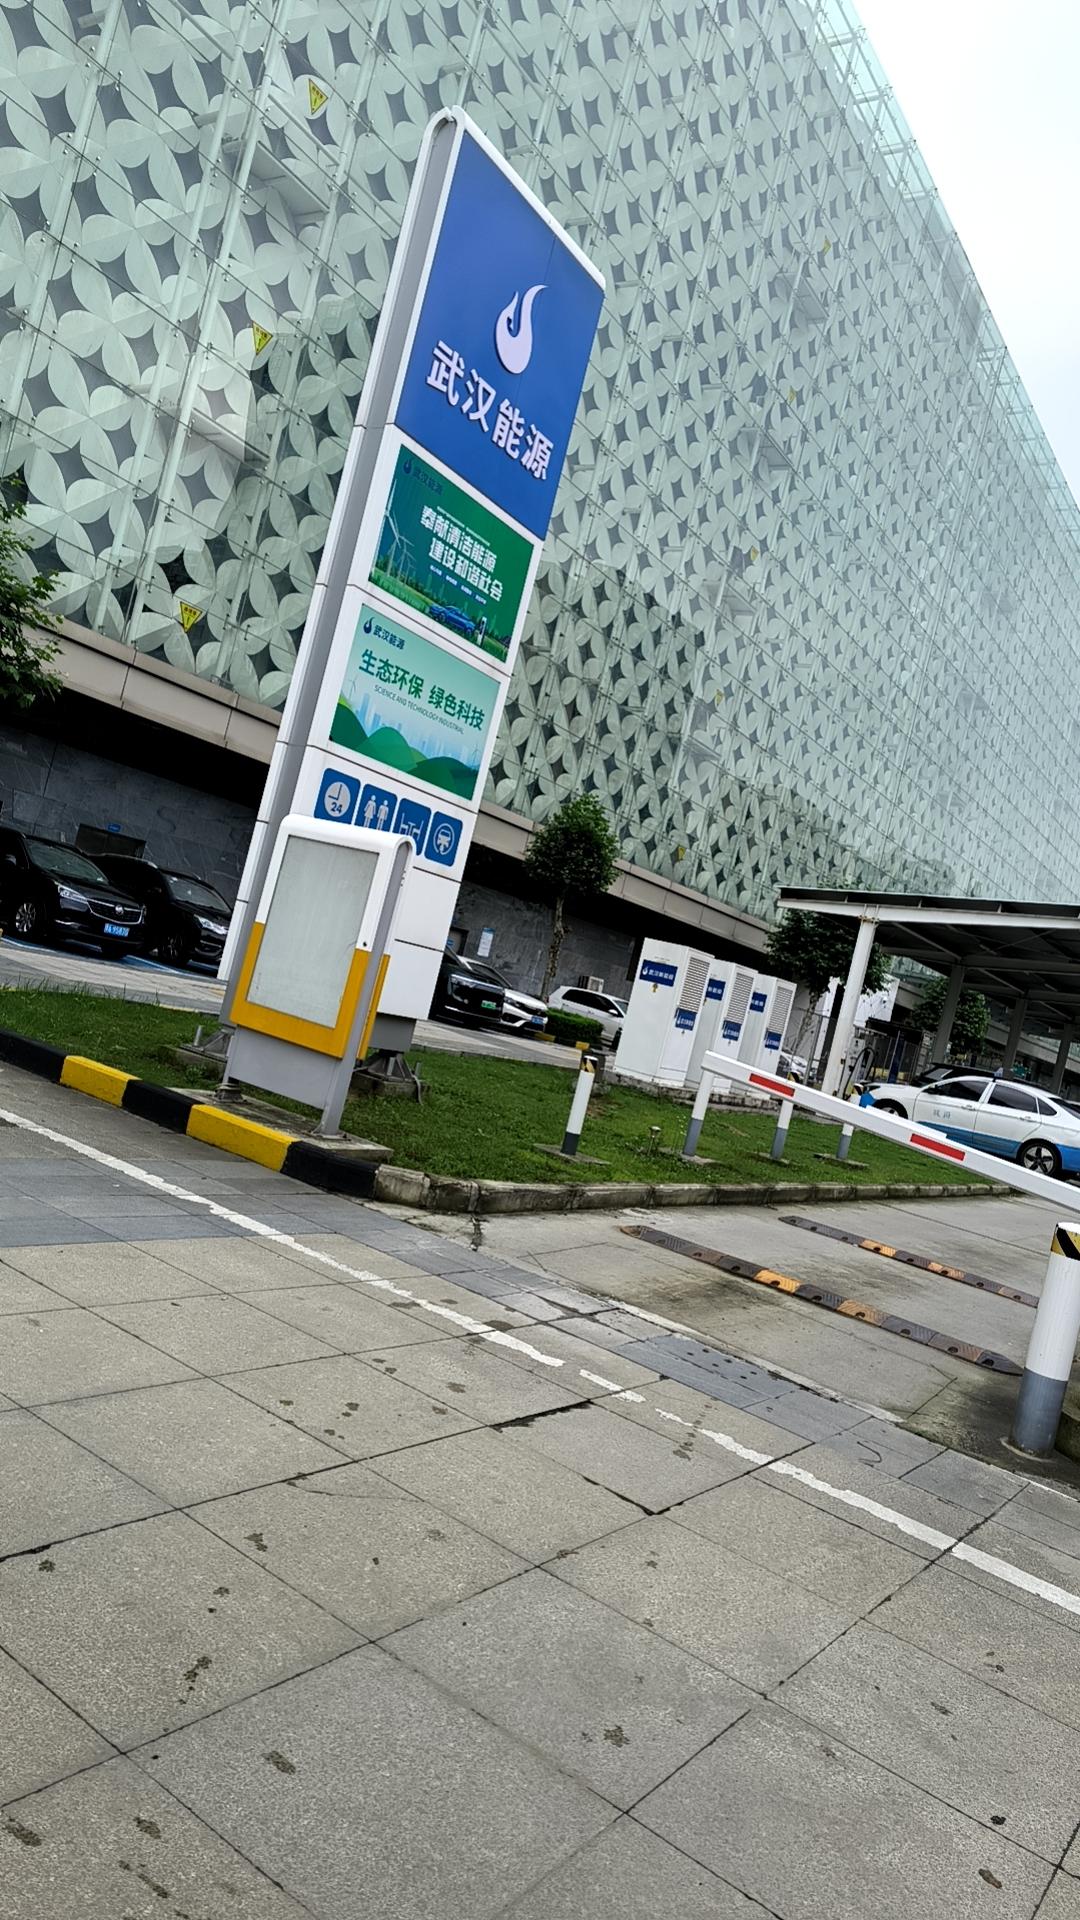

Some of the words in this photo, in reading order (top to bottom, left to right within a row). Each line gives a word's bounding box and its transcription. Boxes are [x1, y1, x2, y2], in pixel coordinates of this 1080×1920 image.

[426, 340, 554, 481] 武汉能源
[420, 505, 497, 573] 奉献清洁能源
[428, 537, 503, 602] 建设和谐社会
[373, 624, 405, 650] 武汉能源
[358, 649, 424, 699] 生态环保
[426, 685, 485, 731] 绿色科技
[374, 684, 396, 702] SCIENCE
[396, 695, 408, 706] AND
[407, 700, 439, 721] TECHNOLOGY
[330, 801, 343, 814] 24
